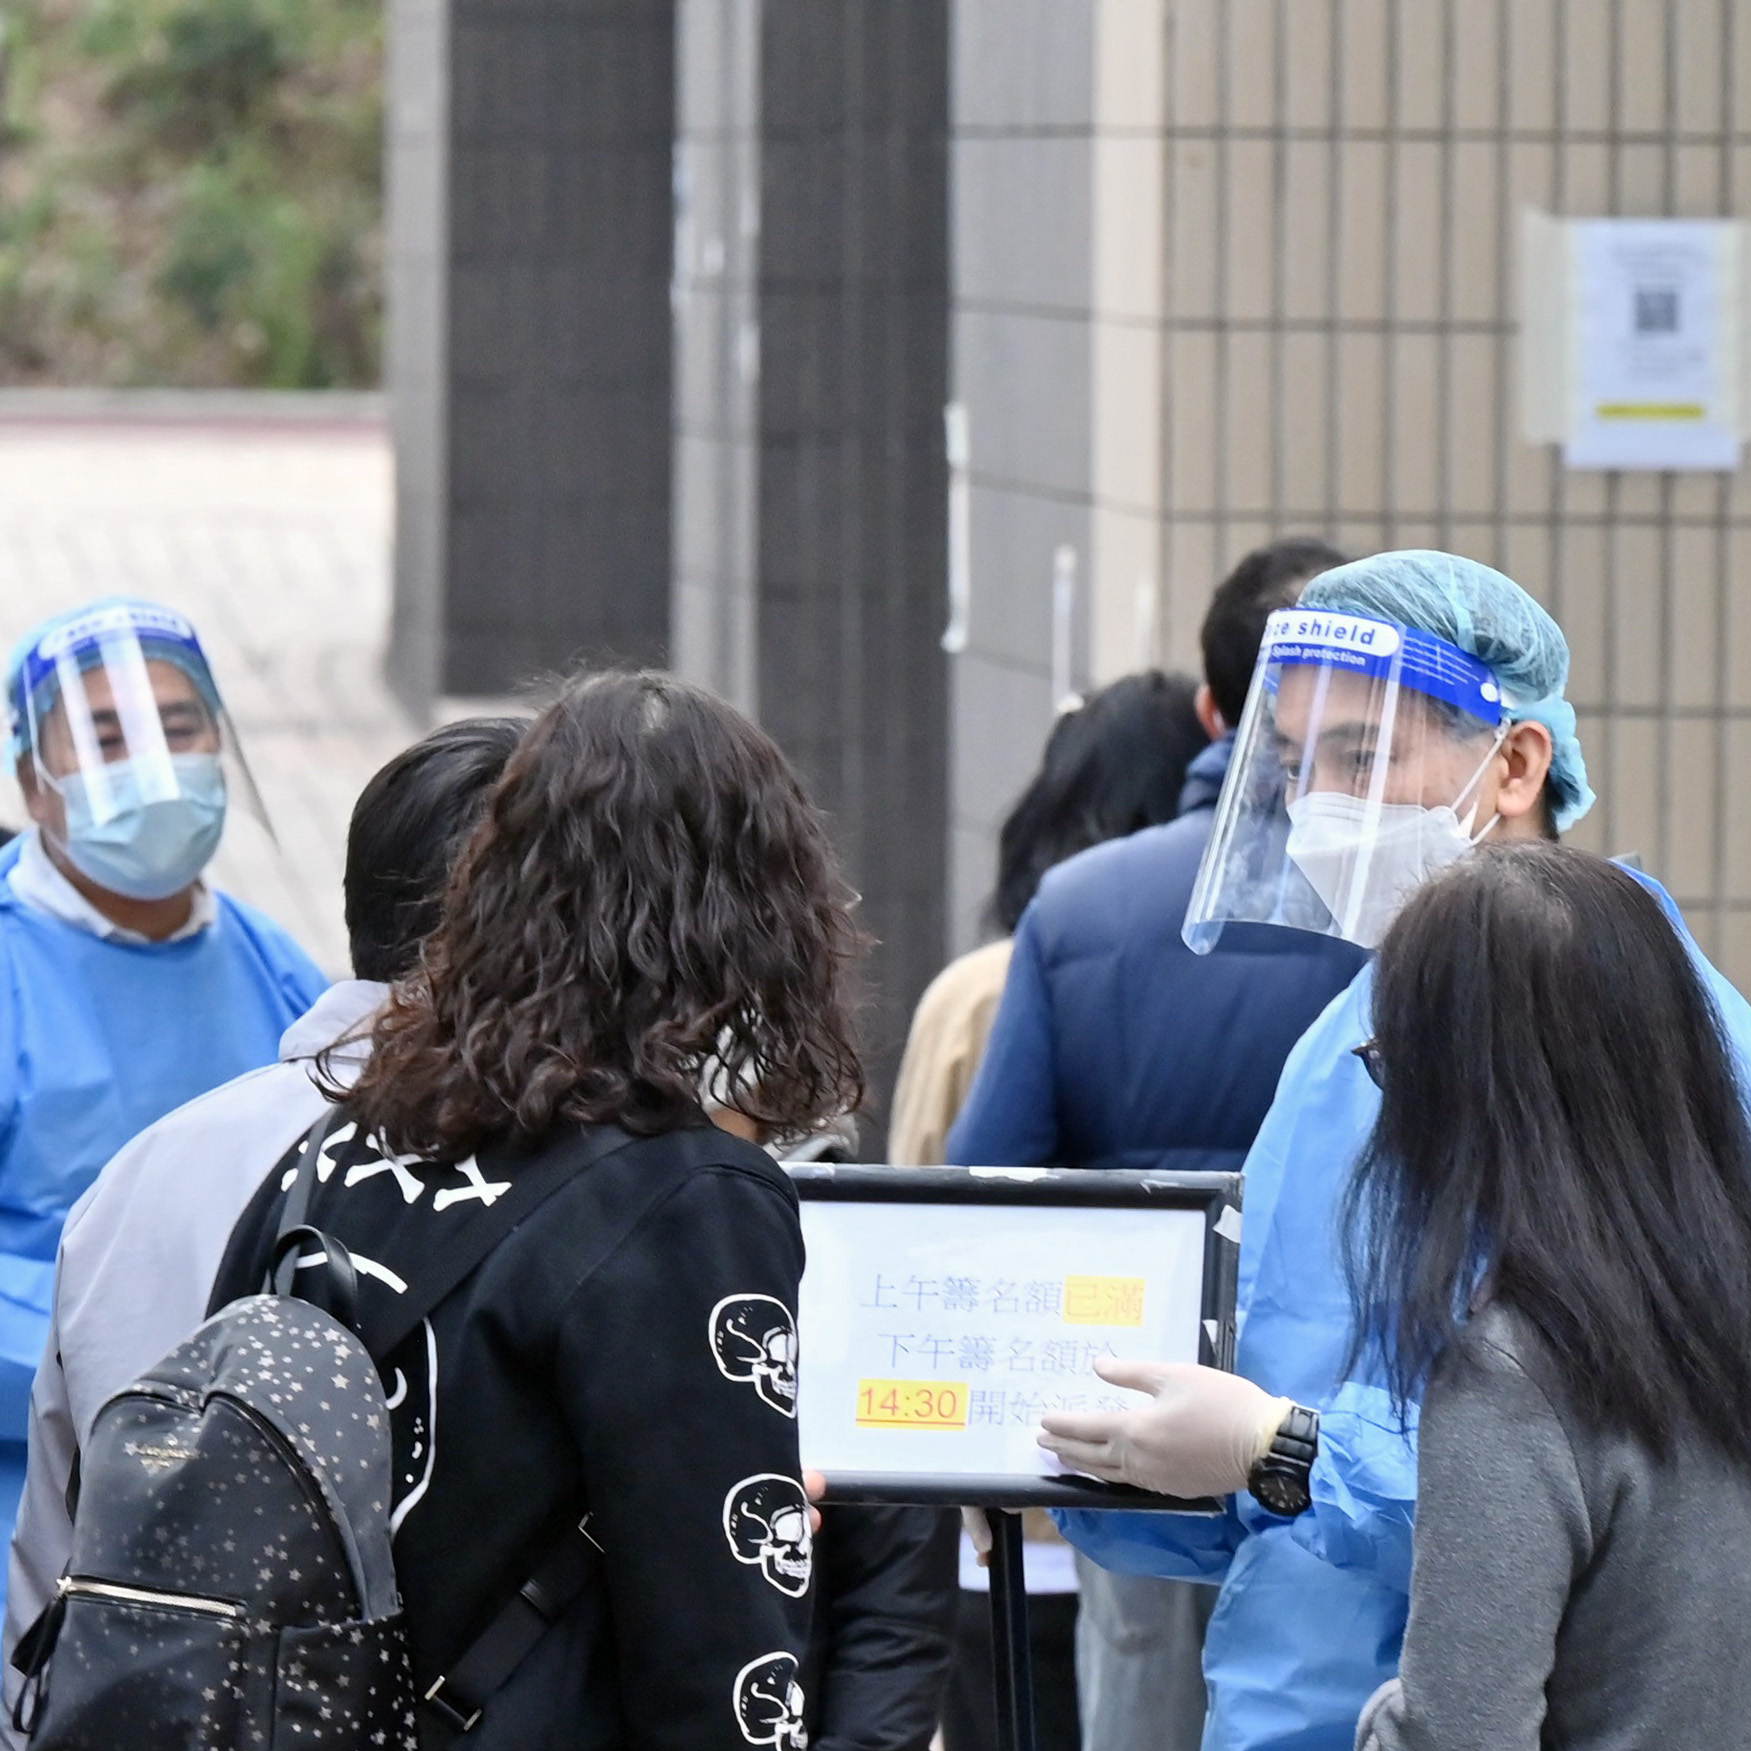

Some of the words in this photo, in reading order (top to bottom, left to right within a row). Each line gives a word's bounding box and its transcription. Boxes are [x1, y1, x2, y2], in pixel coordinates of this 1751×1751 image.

[1297, 617, 1377, 647] shield
[1302, 646, 1367, 668] protection
[860, 1272, 1144, 1322] 上午籌名額已滿
